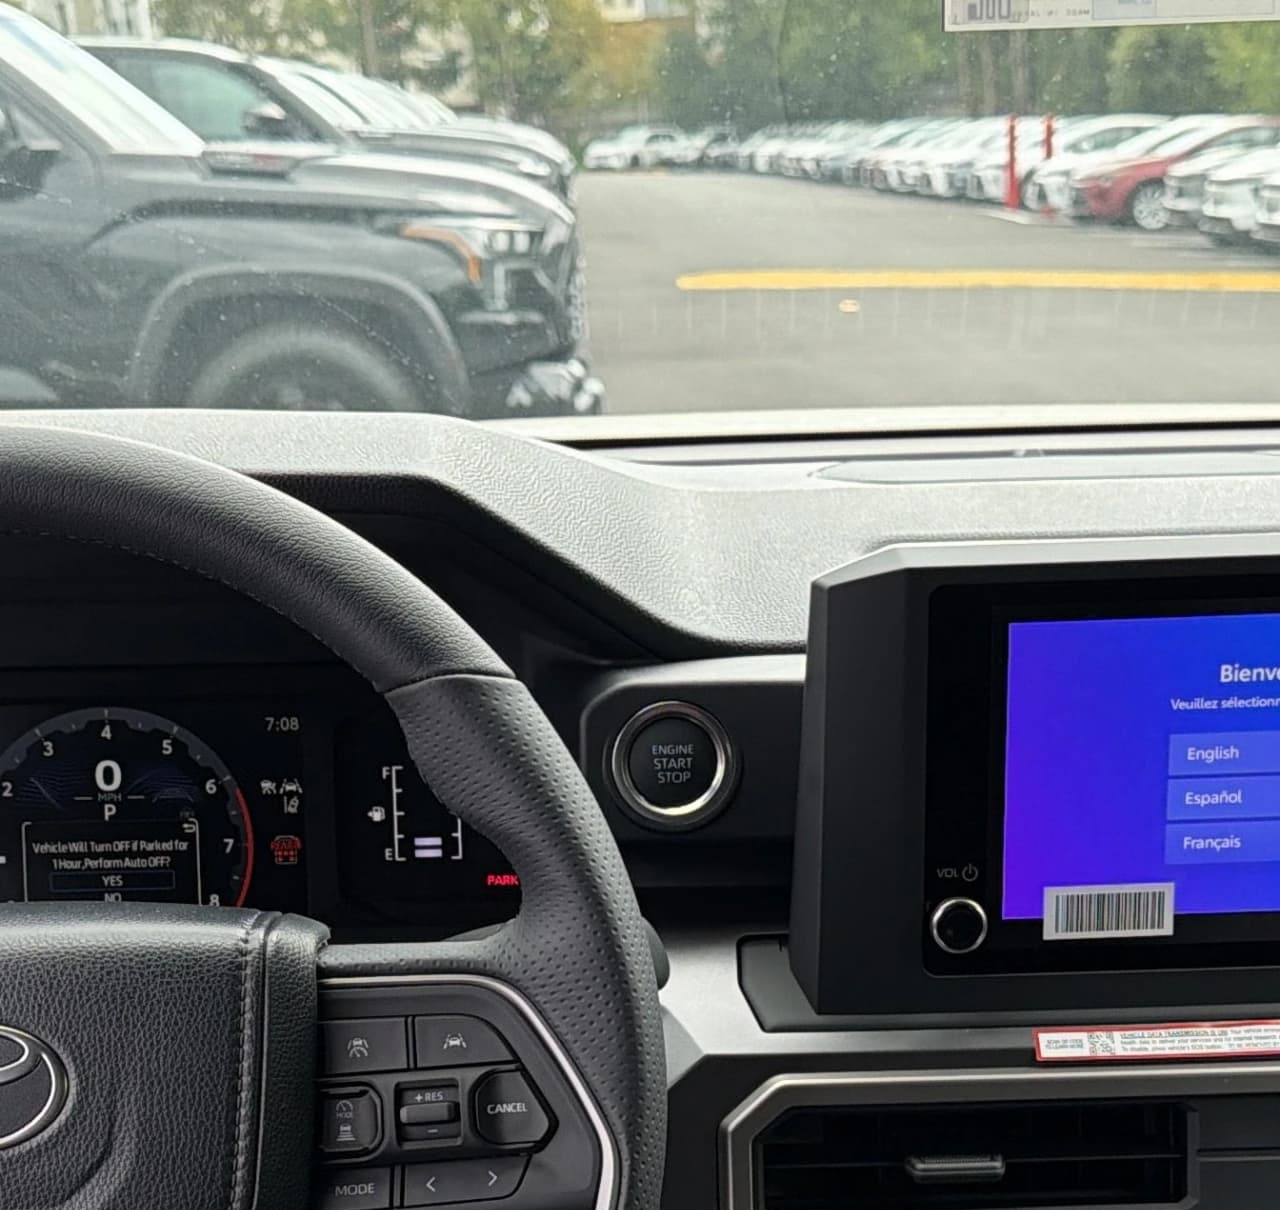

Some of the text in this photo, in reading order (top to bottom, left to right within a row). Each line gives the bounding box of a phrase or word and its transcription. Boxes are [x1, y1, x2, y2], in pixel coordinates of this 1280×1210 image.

[1170, 698, 1218, 710] Veuillez
[264, 717, 299, 731] 7:08
[101, 725, 112, 740] 4
[43, 742, 54, 756] 3
[162, 739, 172, 755] 5
[651, 744, 694, 755] ENGINE
[1187, 746, 1239, 763] English
[654, 758, 693, 770] START
[95, 760, 122, 791] 0
[382, 767, 390, 779] F
[657, 771, 691, 784] STOP
[1, 782, 13, 797] 2
[205, 779, 217, 794] 6
[1185, 789, 1242, 807] Español
[104, 804, 116, 821] P
[32, 842, 68, 854] Vehicle
[68, 841, 87, 852] Will
[89, 841, 111, 852] Turn
[113, 840, 130, 851] OFF
[140, 840, 174, 851] Parked
[175, 840, 188, 850] for
[223, 838, 234, 853] 7
[1183, 834, 1241, 852] Français
[385, 848, 393, 861] E
[936, 868, 959, 878] VOL
[102, 876, 123, 887] YES
[486, 875, 519, 886] PARK
[487, 1103, 528, 1115] CANCEL
[335, 1183, 375, 1197] MODE
